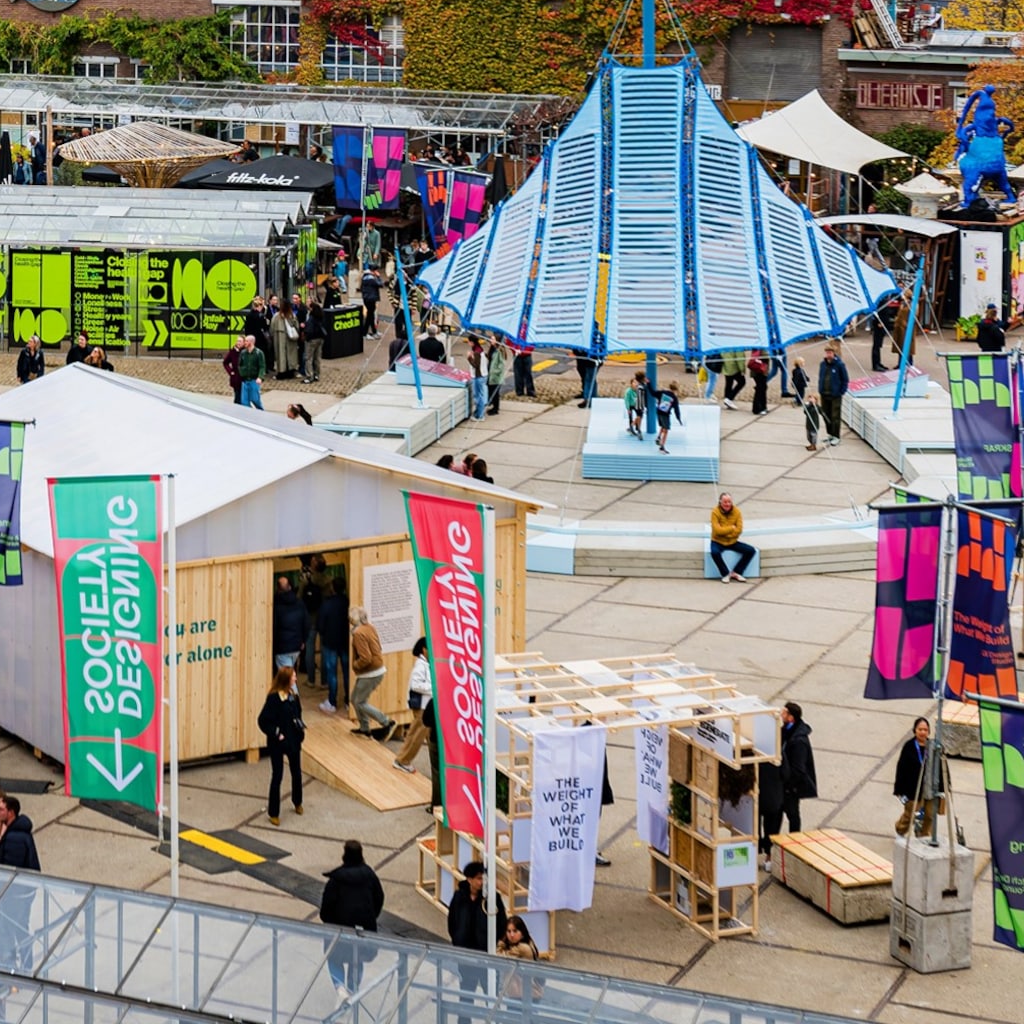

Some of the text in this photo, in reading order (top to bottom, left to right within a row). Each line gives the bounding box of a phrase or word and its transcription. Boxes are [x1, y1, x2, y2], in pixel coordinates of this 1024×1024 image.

[226, 172, 295, 186] fritz-kola
[150, 257, 169, 268] the
[190, 619, 217, 634] are
[187, 645, 233, 661] alone
[555, 777, 580, 789] THE
[543, 788, 594, 803] WEIGHT
[561, 800, 579, 813] OF
[549, 814, 585, 827] WHAT
[558, 827, 580, 839] WE
[548, 839, 585, 852] BUILD
